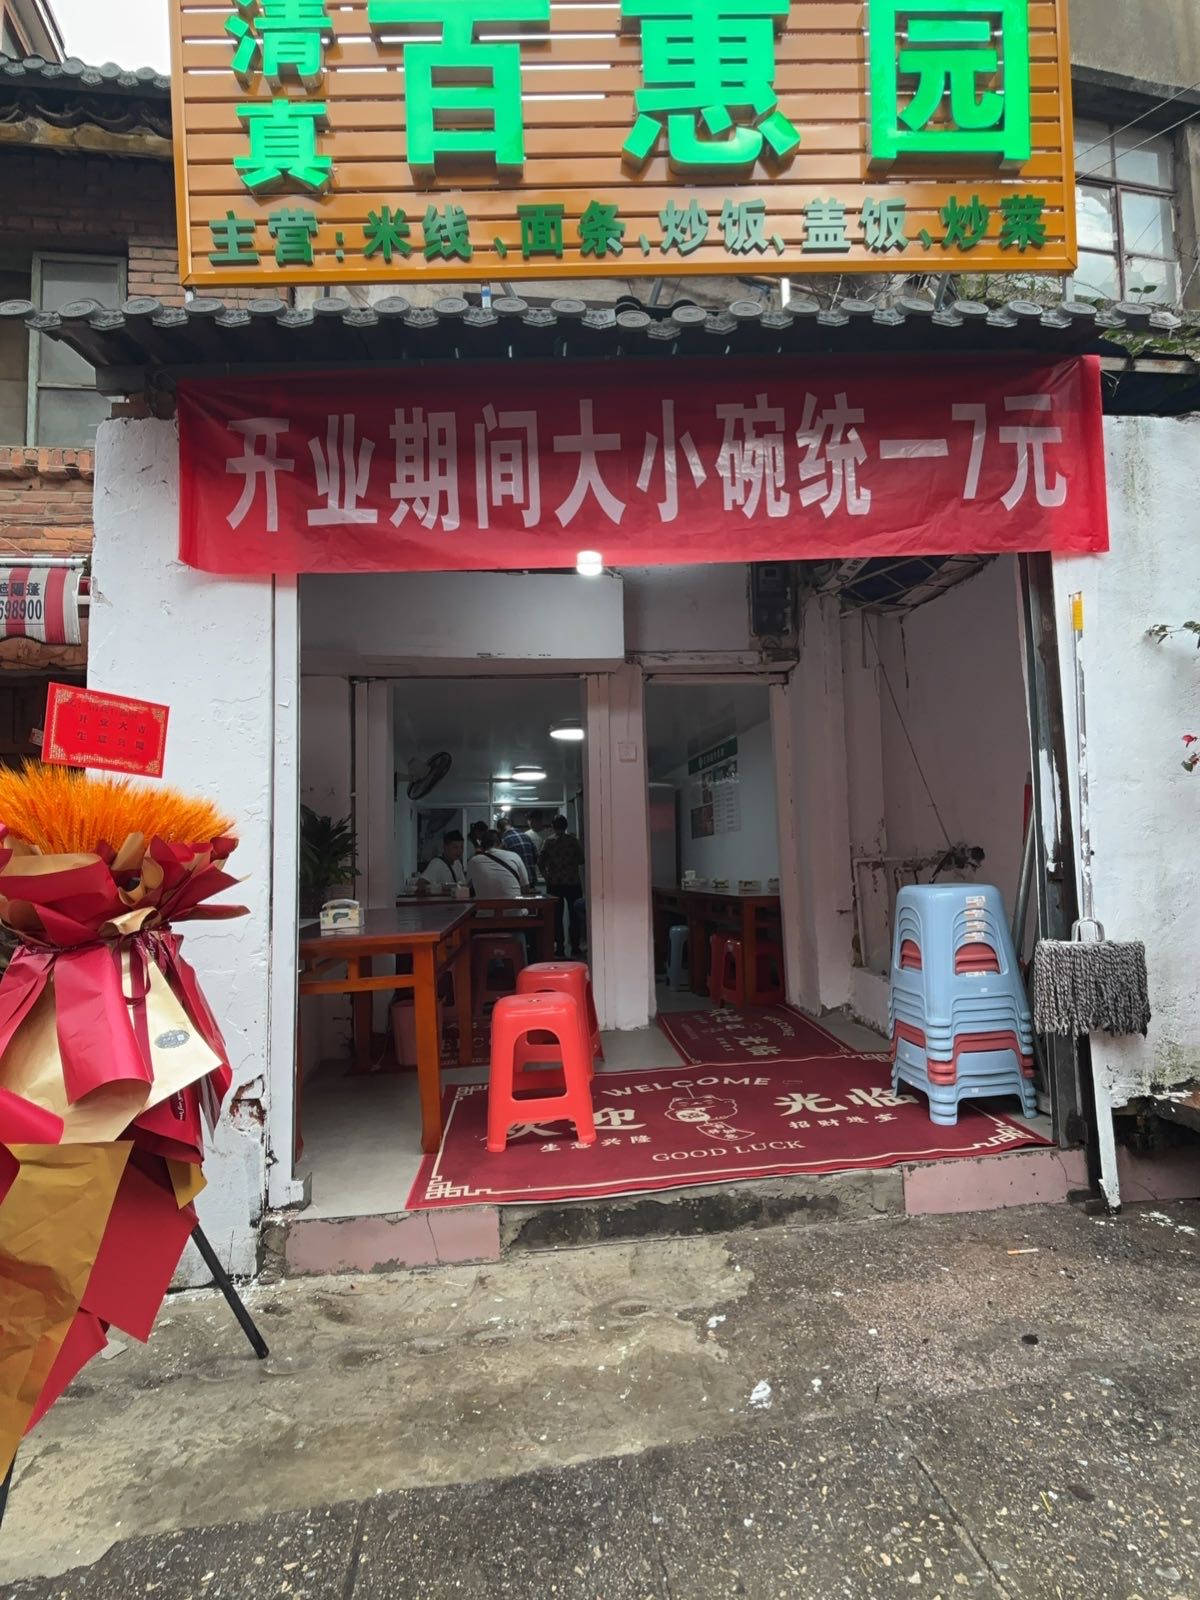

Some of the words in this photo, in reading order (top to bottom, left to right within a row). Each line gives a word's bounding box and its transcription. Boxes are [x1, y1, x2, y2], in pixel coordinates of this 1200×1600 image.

[224, 0, 333, 189] 清真
[367, 0, 1031, 168] 百惠园
[225, 392, 1068, 533] 开业期间大小碗统一7元
[602, 1076, 772, 1098] WELCOME
[773, 1086, 920, 1117] 光临
[651, 1147, 728, 1163] GOOD
[735, 1140, 806, 1155] LUCK
